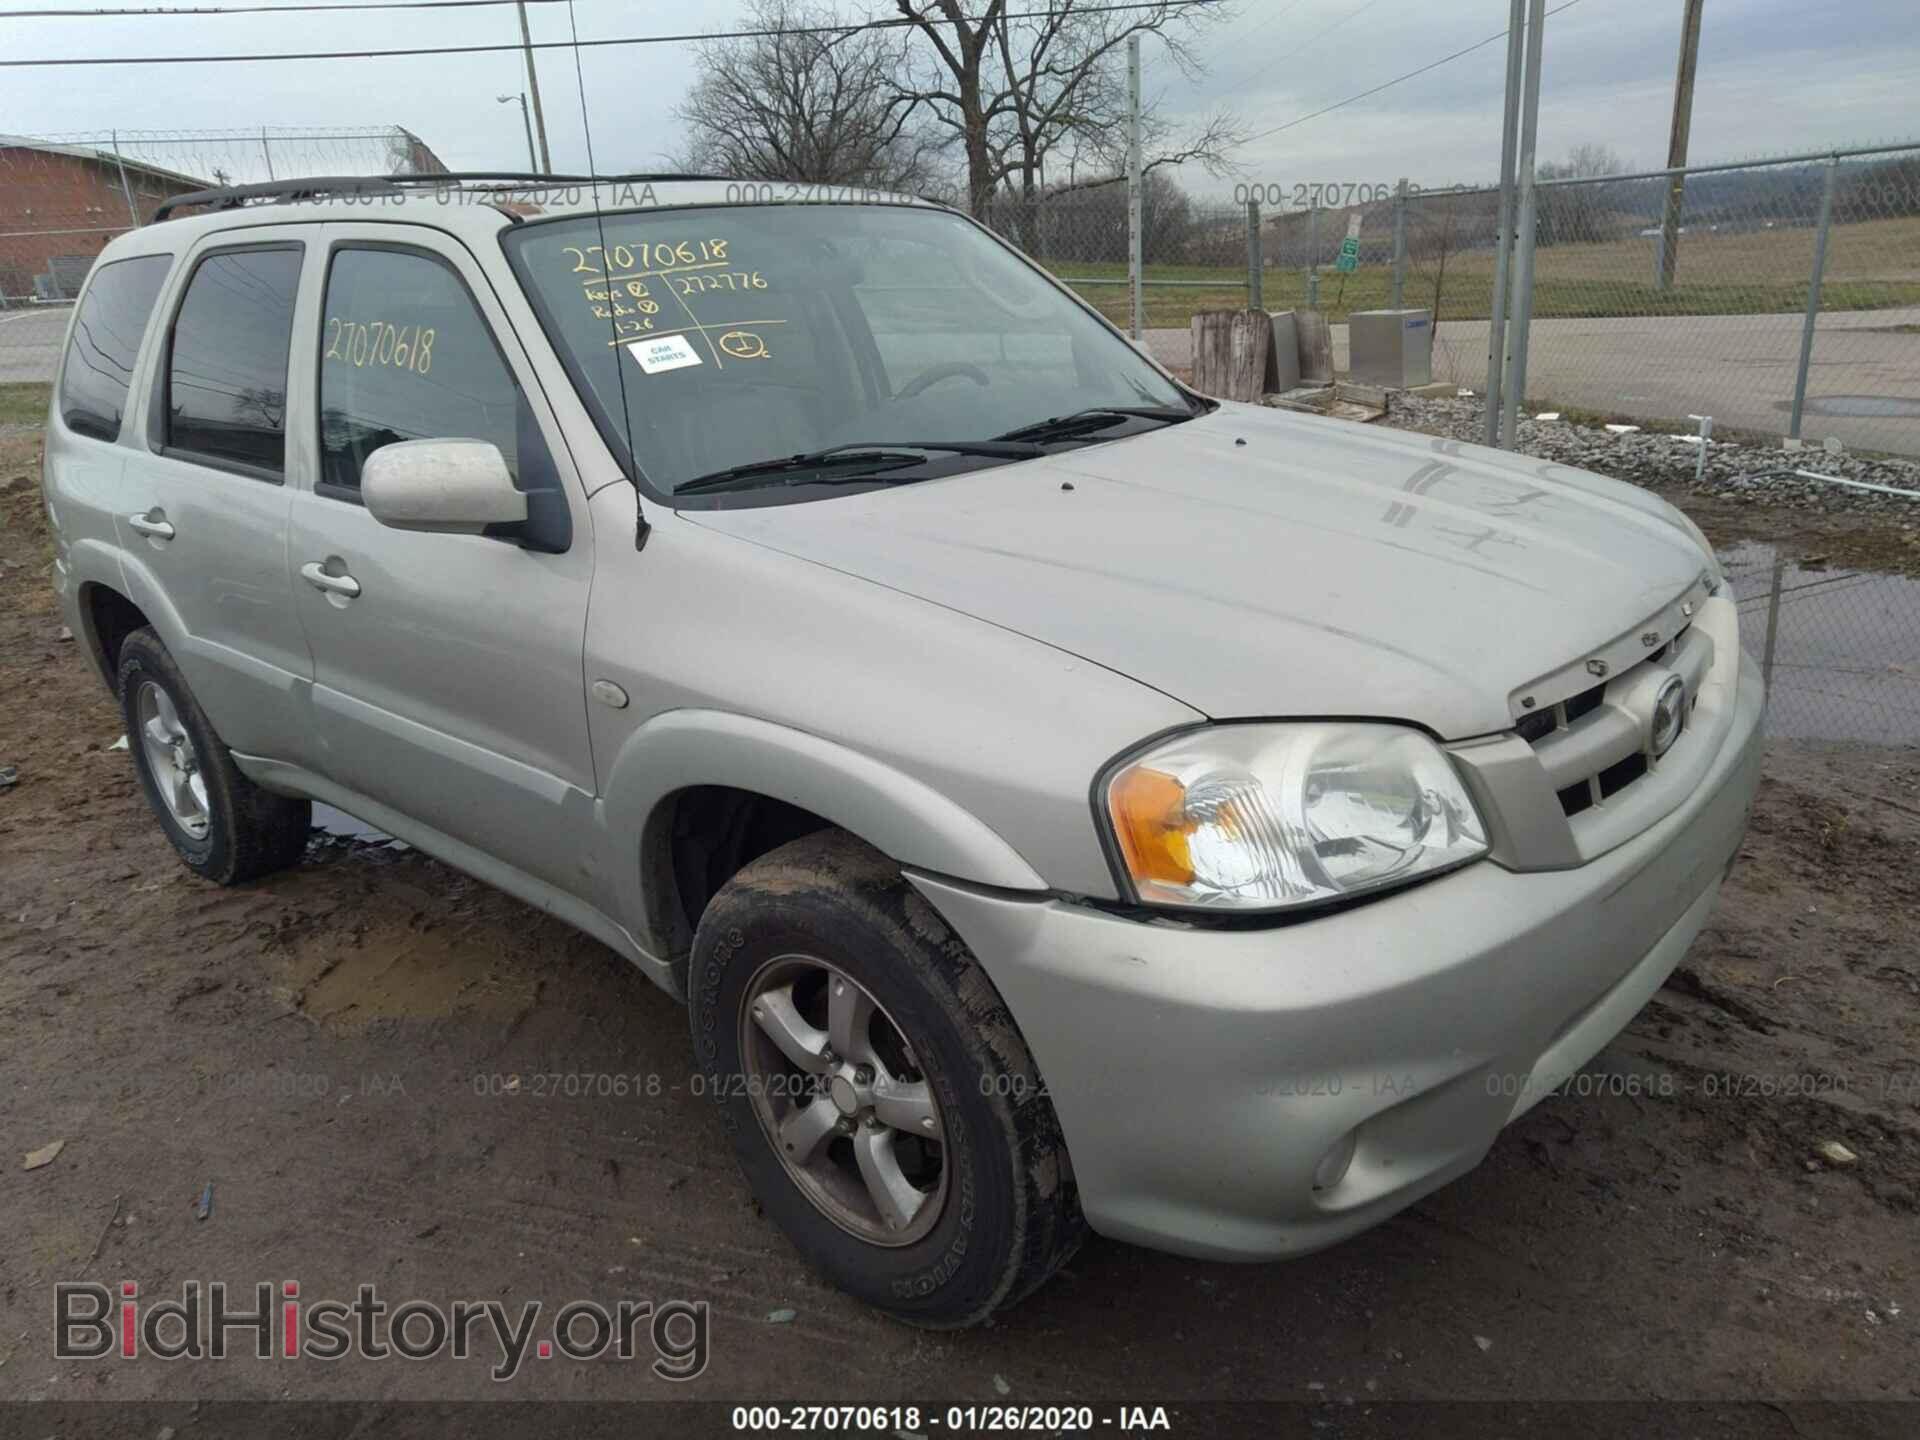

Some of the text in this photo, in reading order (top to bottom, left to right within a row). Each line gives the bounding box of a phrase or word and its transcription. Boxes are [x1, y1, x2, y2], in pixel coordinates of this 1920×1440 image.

[562, 239, 728, 272] 27070618
[674, 271, 768, 294] 272776
[615, 318, 654, 334] 1-26
[326, 318, 435, 374] 27070618
[647, 352, 687, 364] STARTS
